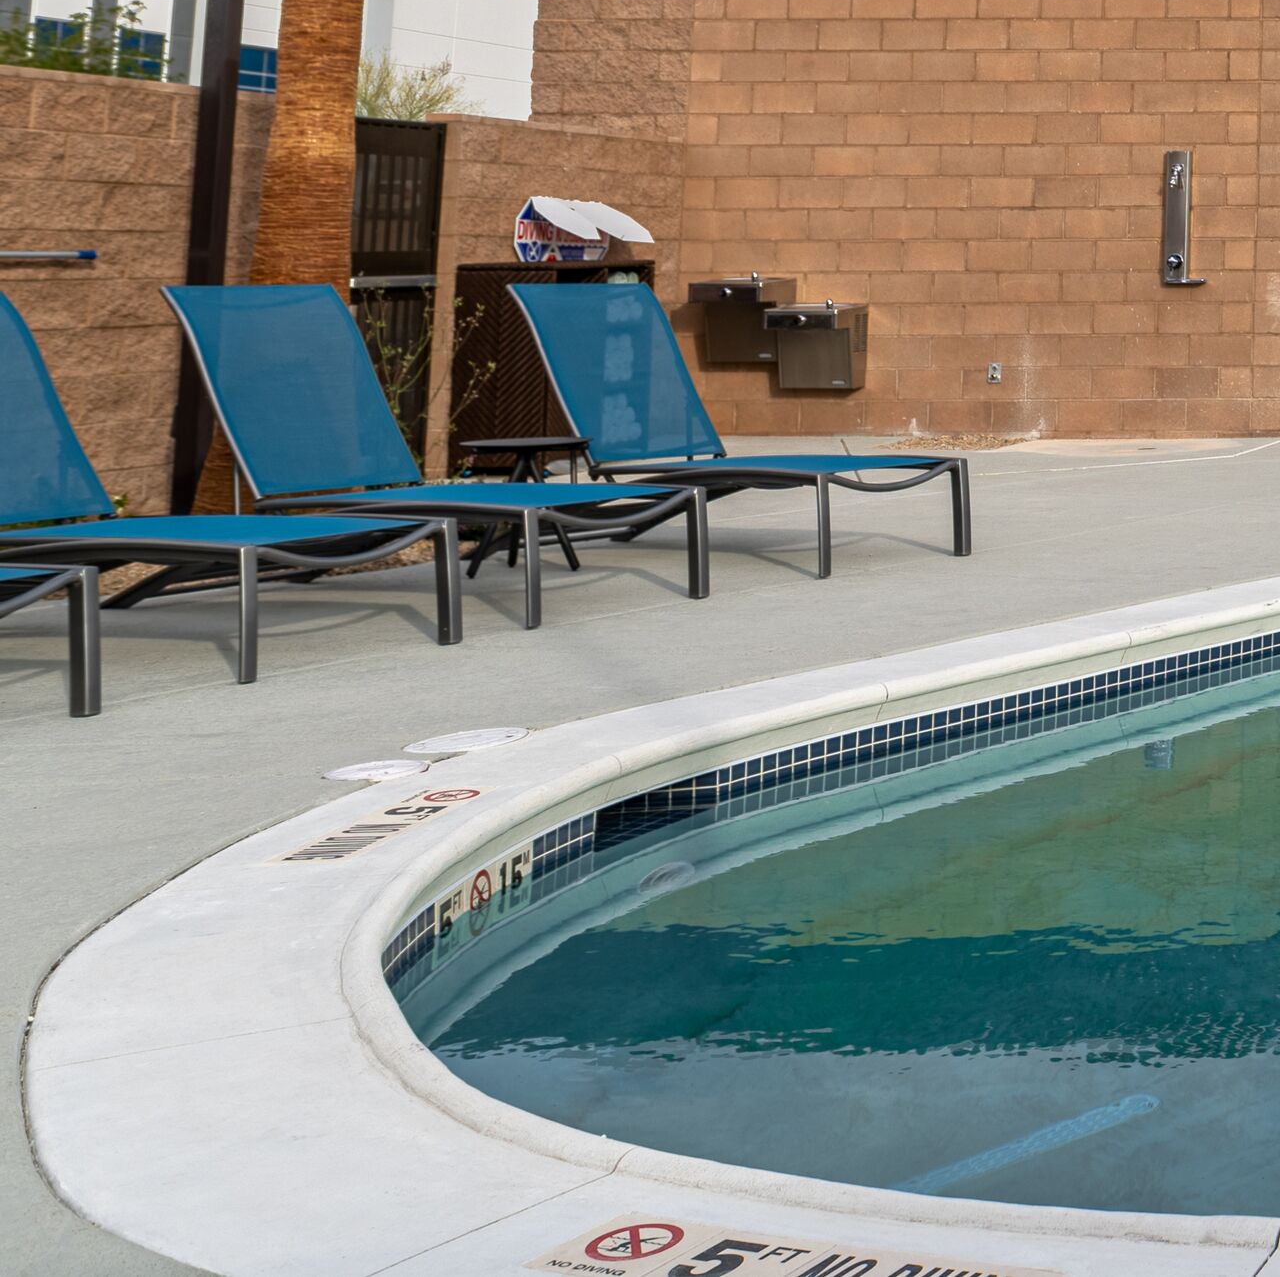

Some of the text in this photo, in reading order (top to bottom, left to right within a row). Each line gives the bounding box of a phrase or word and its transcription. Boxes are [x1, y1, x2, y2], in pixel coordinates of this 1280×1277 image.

[517, 221, 553, 241] DIVING
[384, 805, 448, 815] 5
[523, 849, 530, 866] M
[440, 890, 462, 939] 5 FT
[668, 1239, 770, 1277] 5
[758, 1246, 811, 1263] FT
[546, 1259, 626, 1277] NO DIVING
